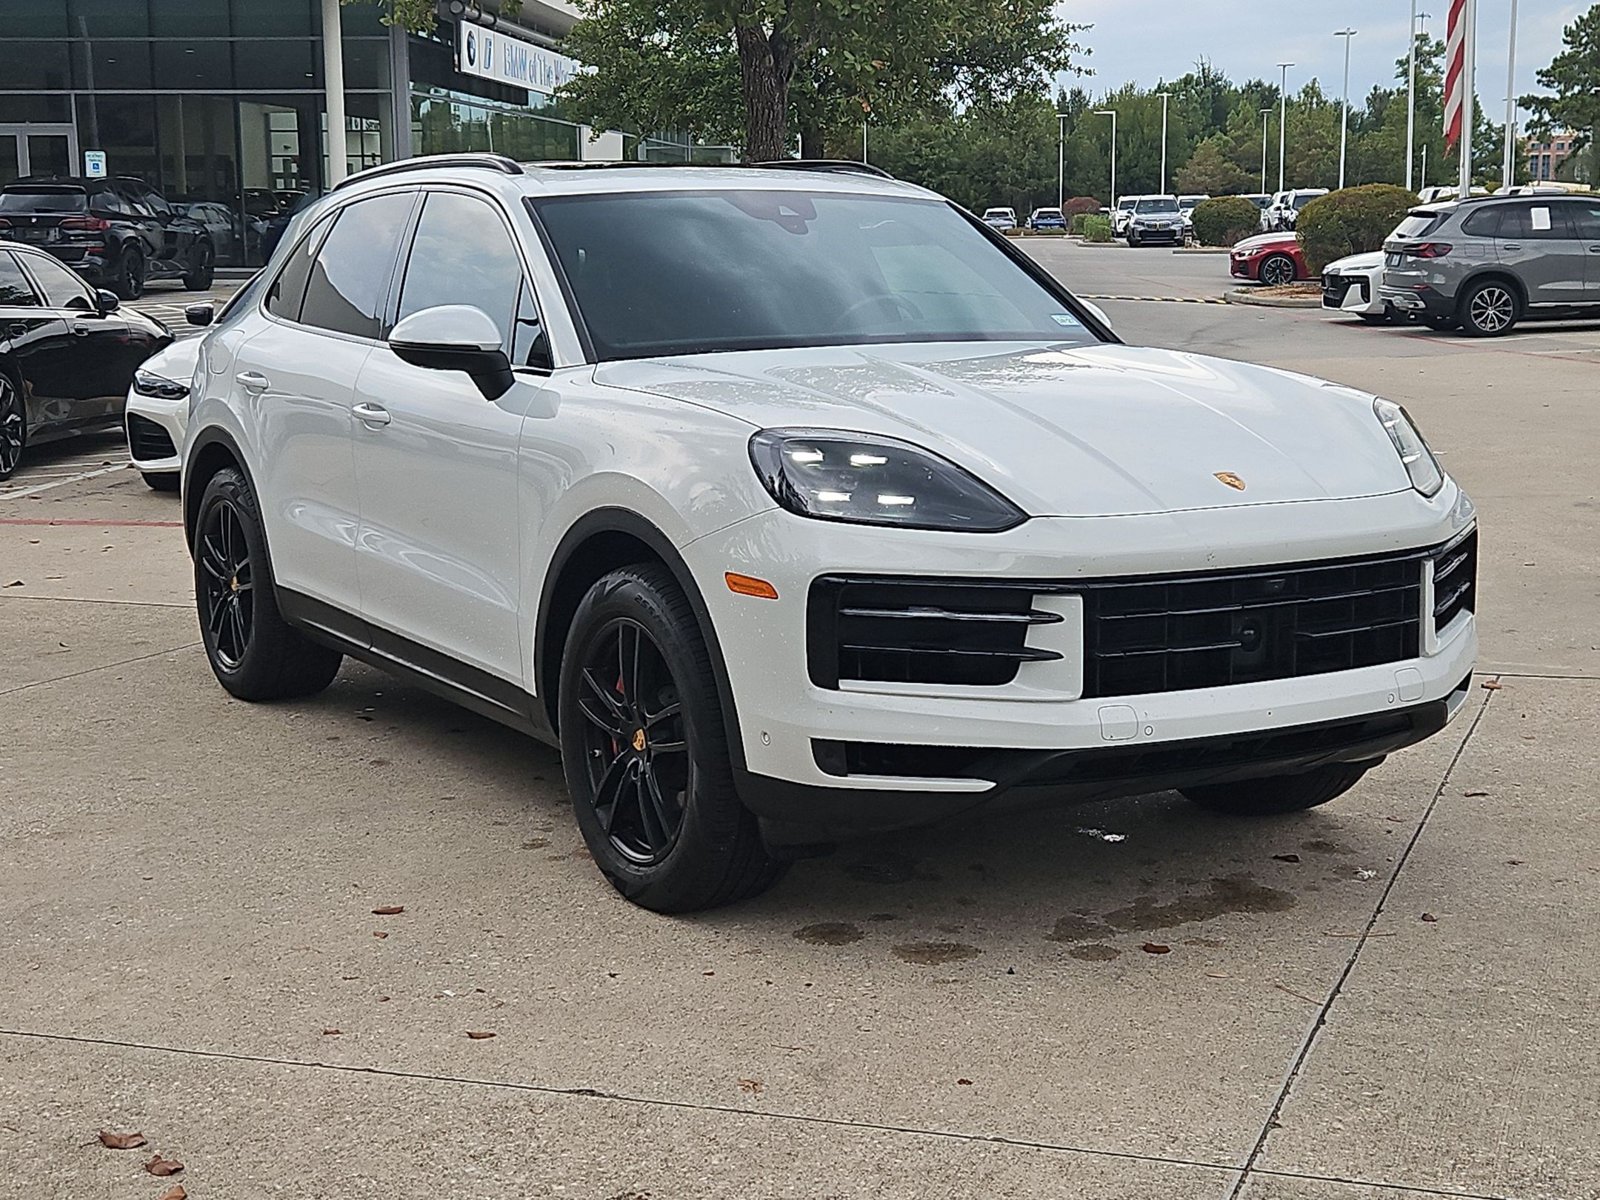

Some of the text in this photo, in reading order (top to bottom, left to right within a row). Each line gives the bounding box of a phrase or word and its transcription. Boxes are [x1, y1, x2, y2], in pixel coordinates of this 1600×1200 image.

[504, 43, 527, 82] BMW
[529, 53, 537, 85] of
[537, 54, 553, 88] The
